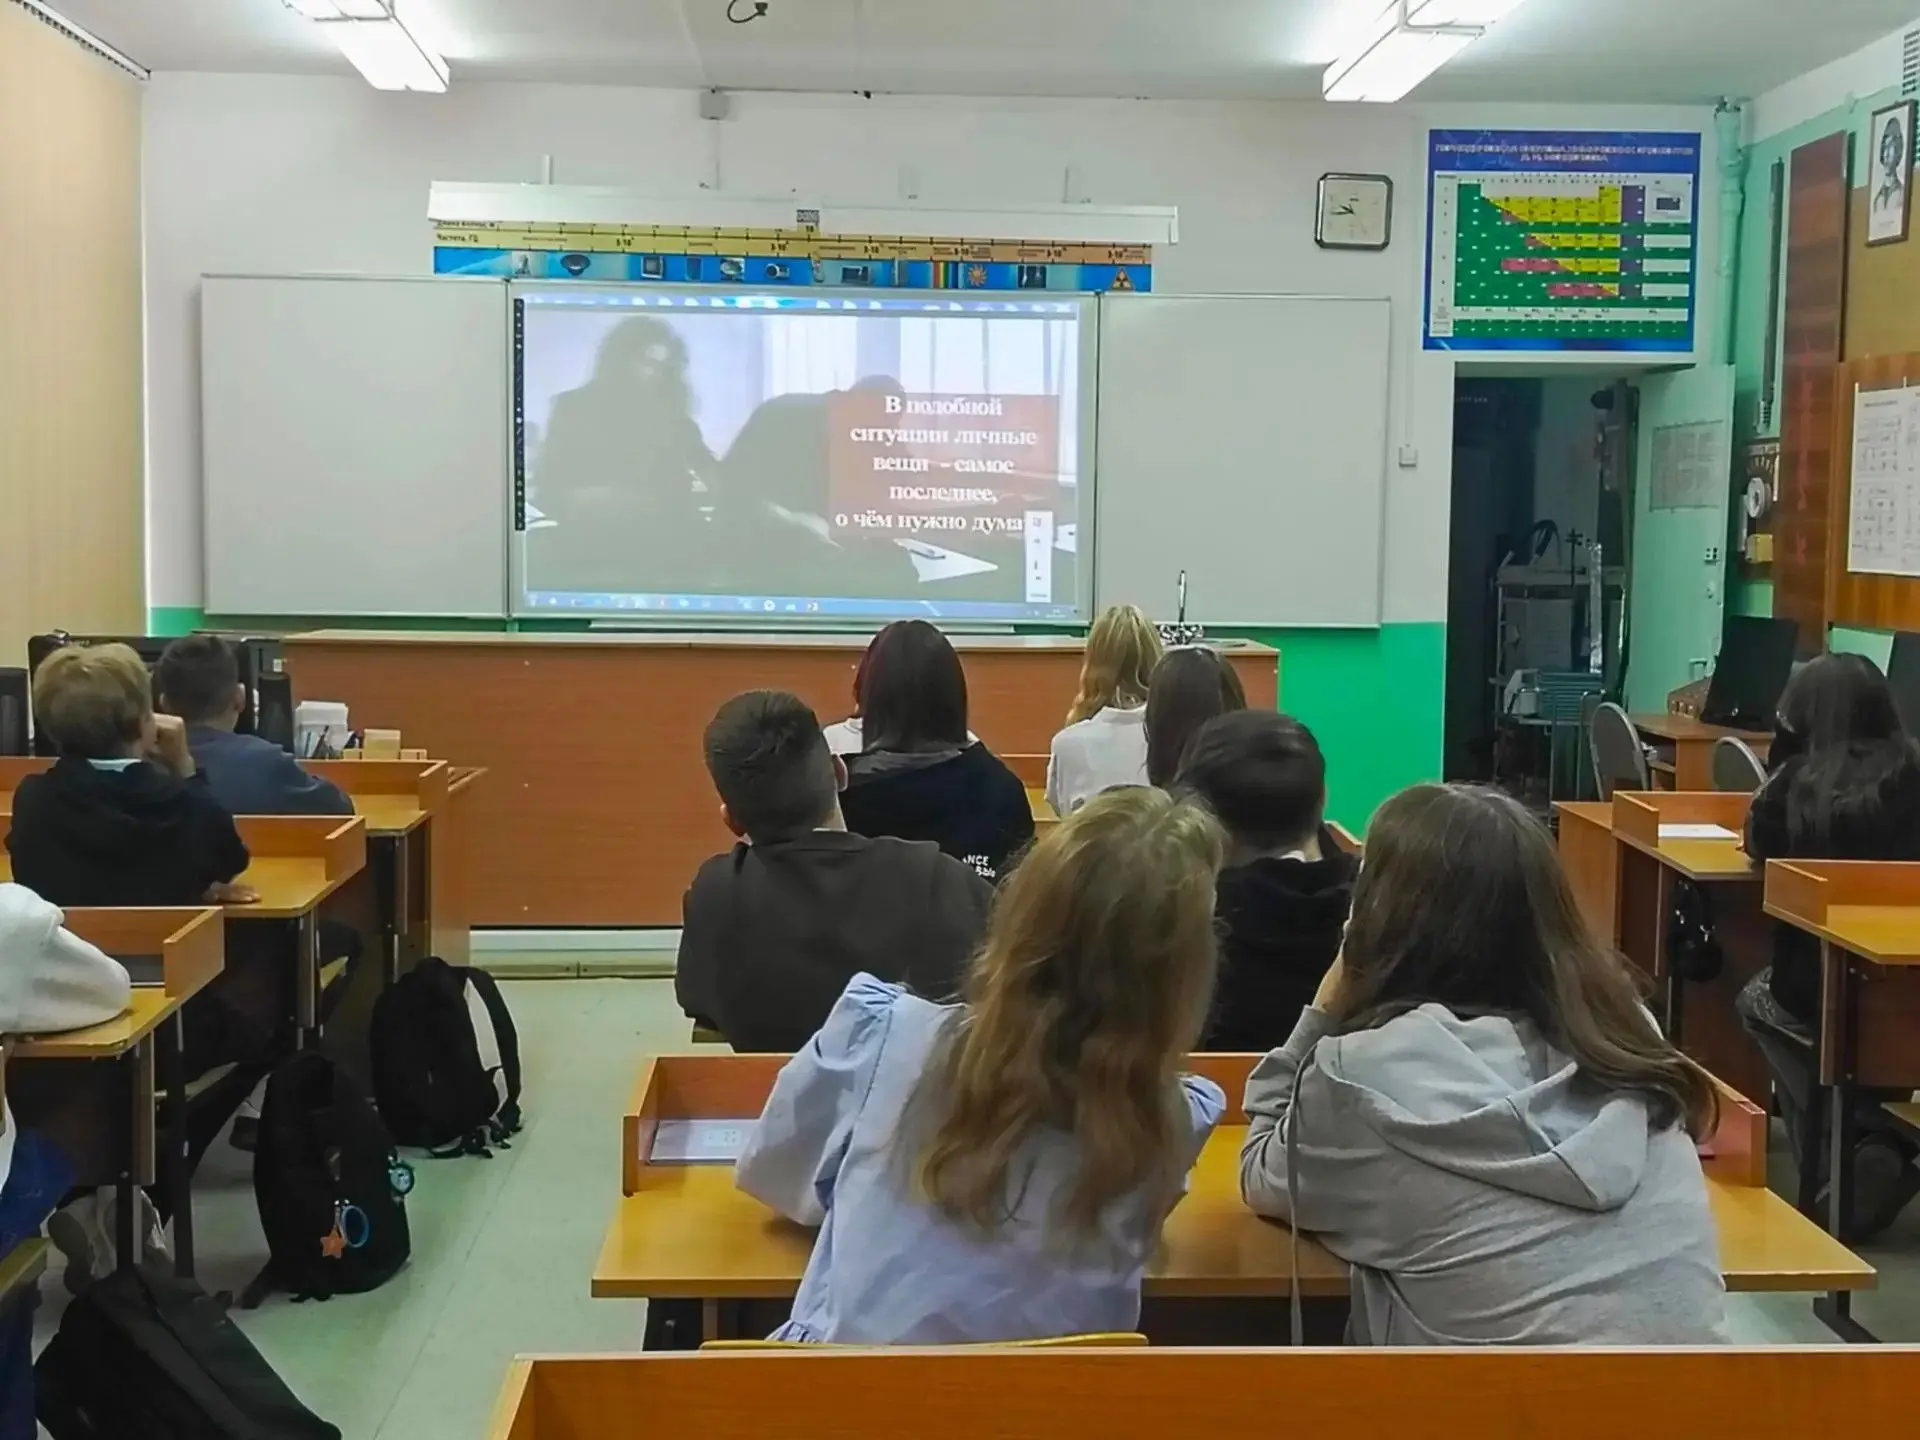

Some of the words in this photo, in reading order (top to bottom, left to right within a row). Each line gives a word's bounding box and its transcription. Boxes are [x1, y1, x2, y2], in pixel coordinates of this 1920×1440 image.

[885, 395, 902, 414] В
[906, 397, 1003, 416] подобной
[849, 428, 949, 447] ситуации
[954, 430, 1038, 446] личные
[872, 456, 930, 474] вещи
[954, 458, 1015, 474] самое
[888, 485, 999, 504] последнее,
[834, 512, 849, 528] о
[853, 510, 893, 529] чём
[898, 513, 967, 533] нужно
[971, 514, 1023, 535] дума
